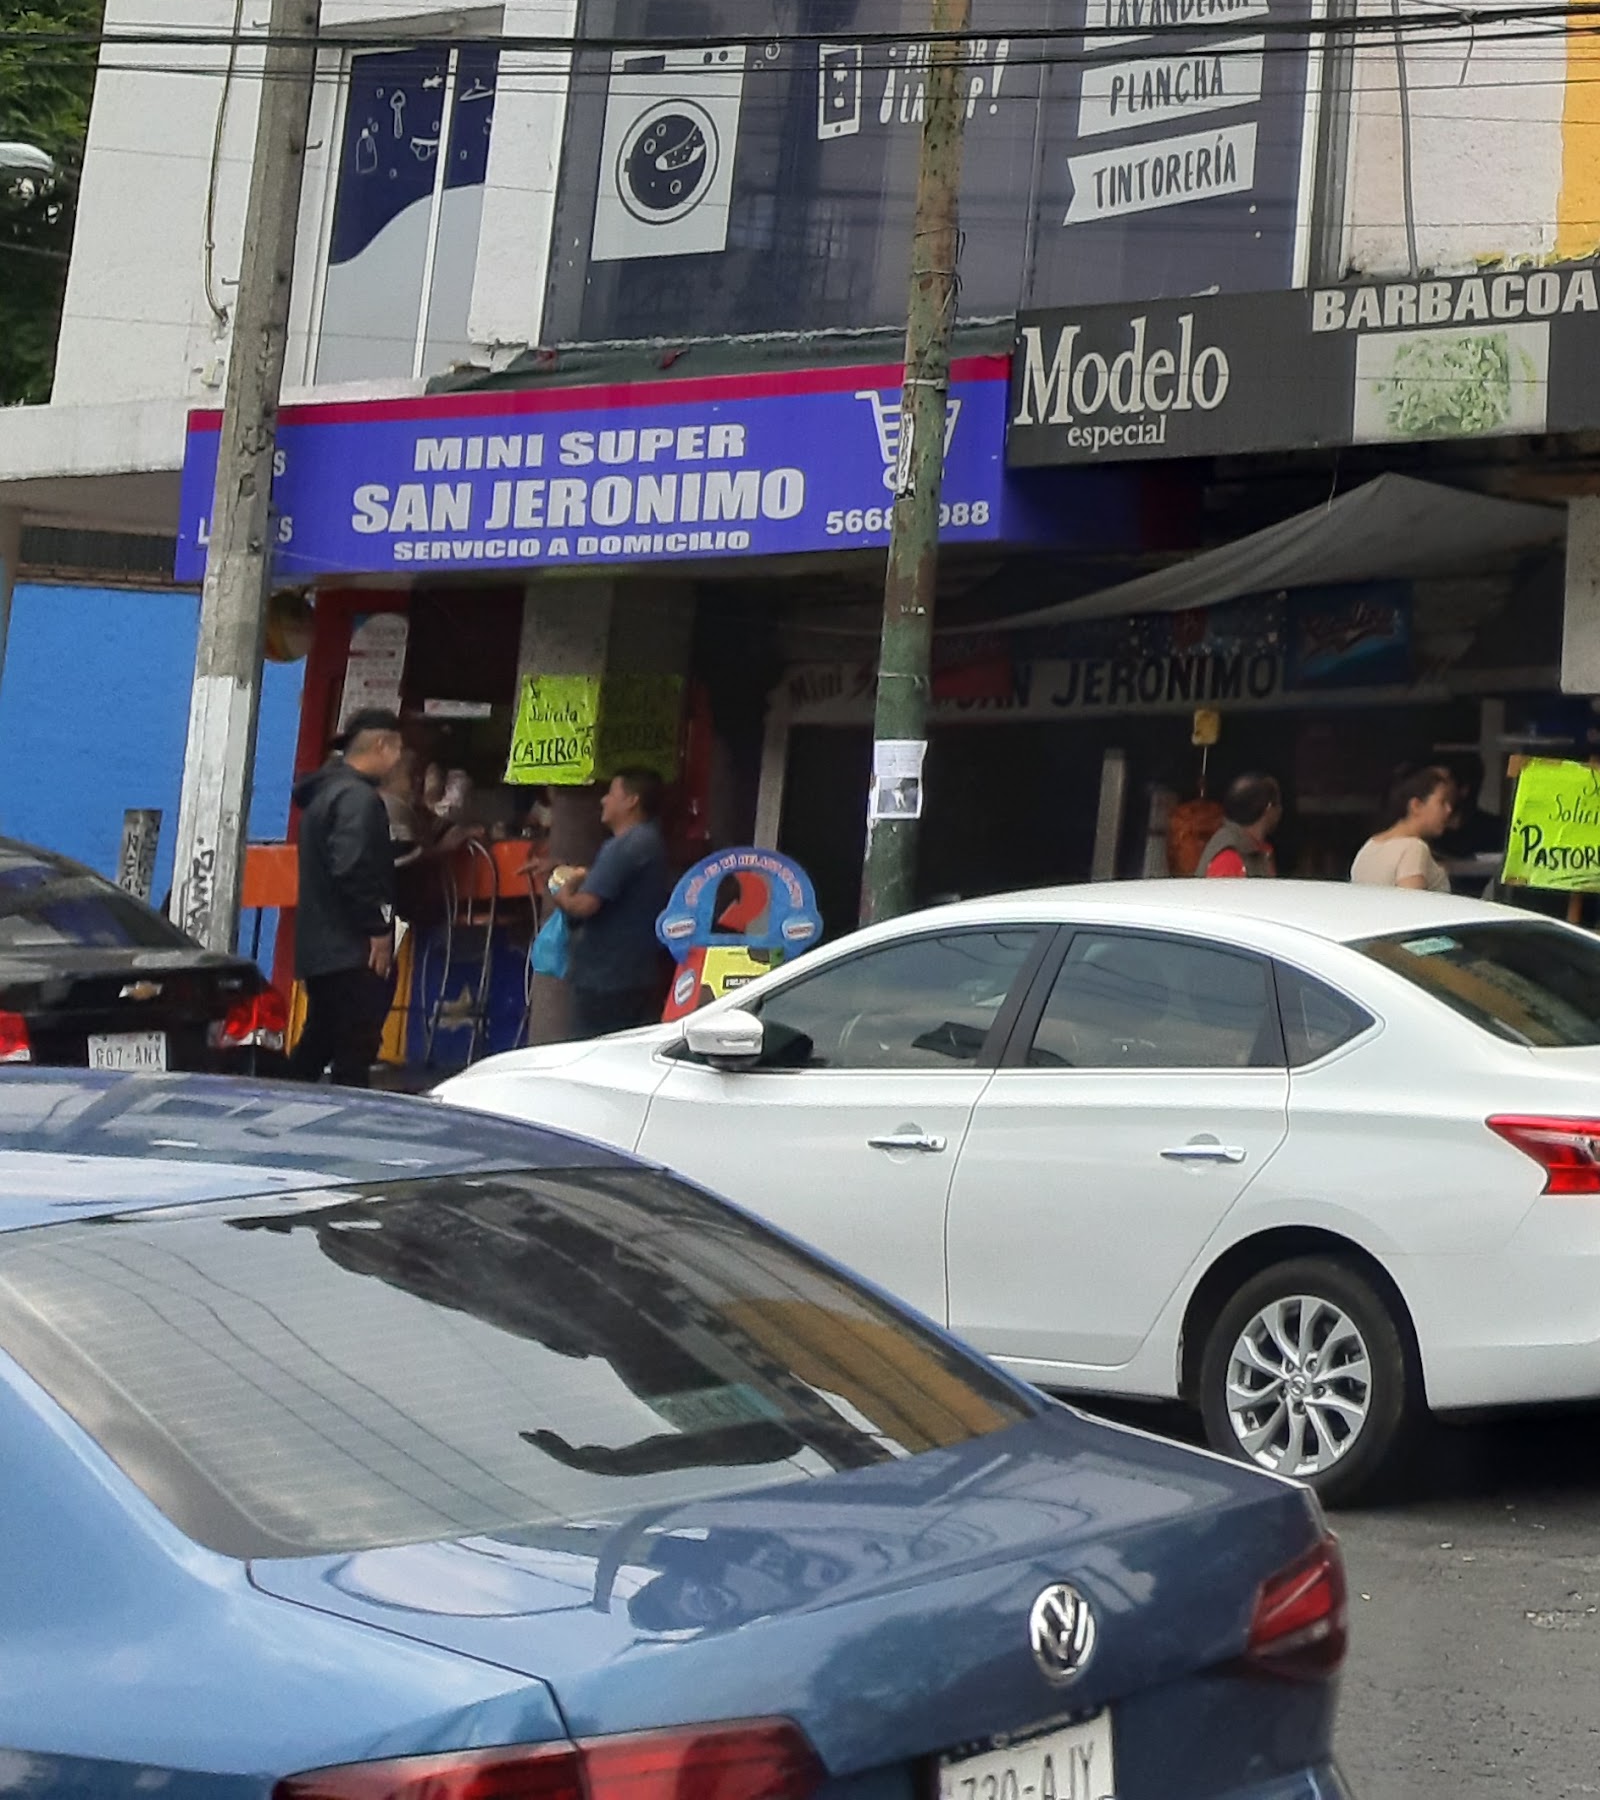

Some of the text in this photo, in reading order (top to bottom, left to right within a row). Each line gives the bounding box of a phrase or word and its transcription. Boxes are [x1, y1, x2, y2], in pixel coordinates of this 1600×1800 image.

[1110, 56, 1223, 117] PLANCHA
[1092, 133, 1237, 210] TINTORERÍA
[1312, 269, 1598, 333] BARBACOA
[1014, 314, 1230, 427] Modelo
[414, 423, 746, 471] MINI SUPER
[1067, 413, 1167, 450] especial
[352, 484, 471, 533] SAN
[484, 468, 806, 531] JERONIMO
[393, 530, 751, 562] SERVICIO A DOMICILIO
[1051, 653, 1281, 704] JERONIMO
